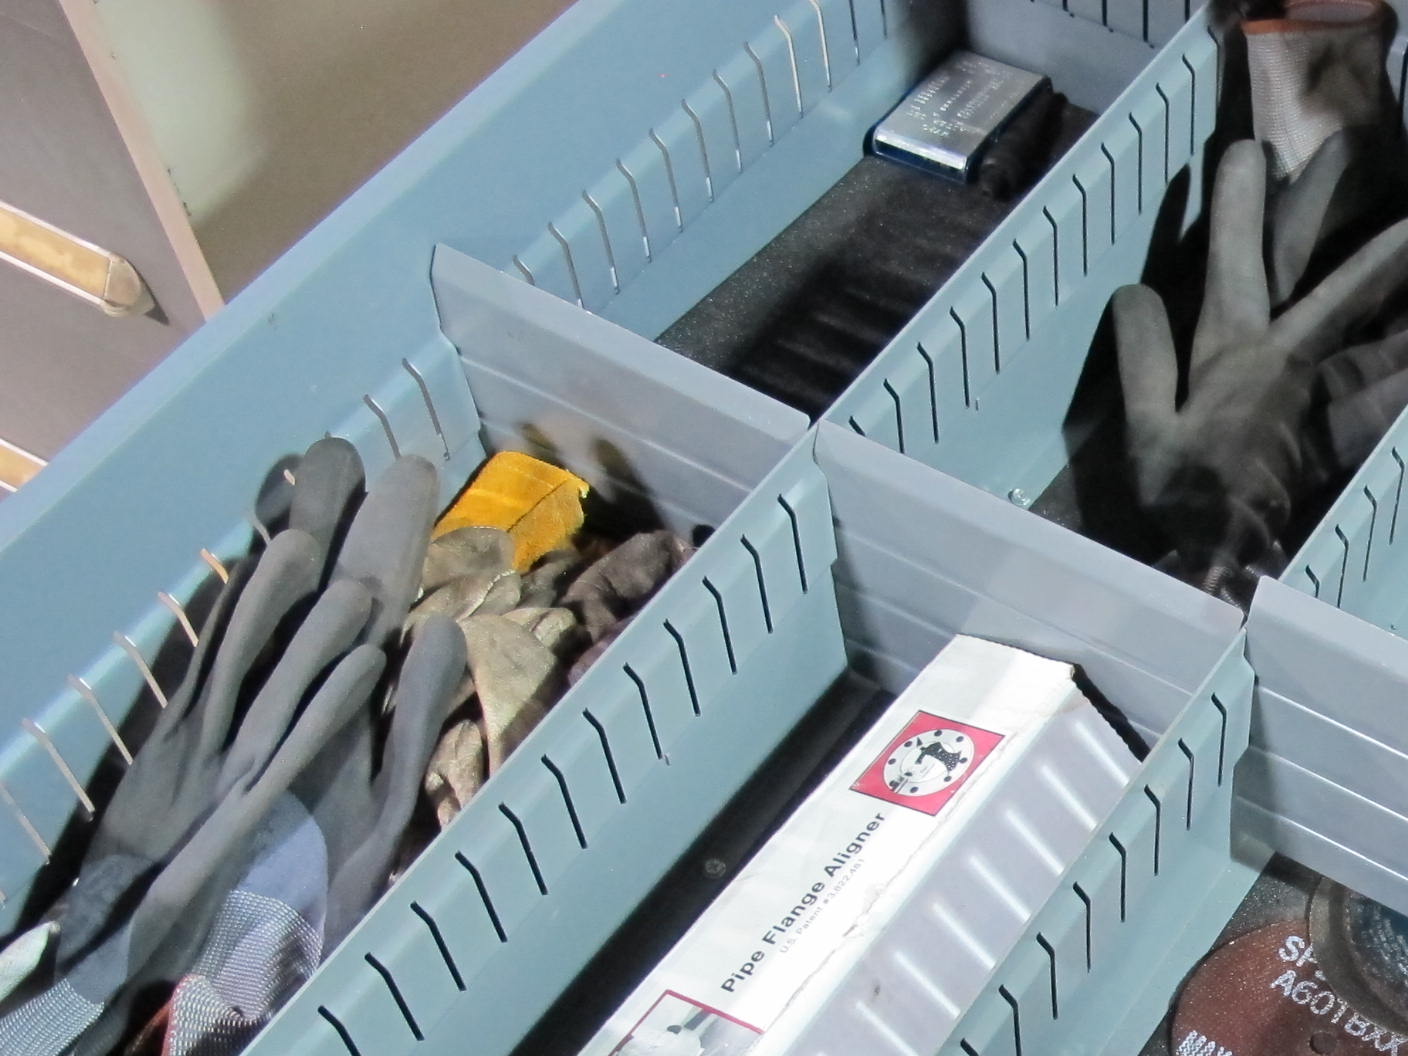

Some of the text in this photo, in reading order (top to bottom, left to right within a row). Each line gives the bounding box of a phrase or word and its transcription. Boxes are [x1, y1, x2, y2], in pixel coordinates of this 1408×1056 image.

[720, 811, 886, 993] Pipe Flange Aligner
[796, 906, 824, 936] Patent
